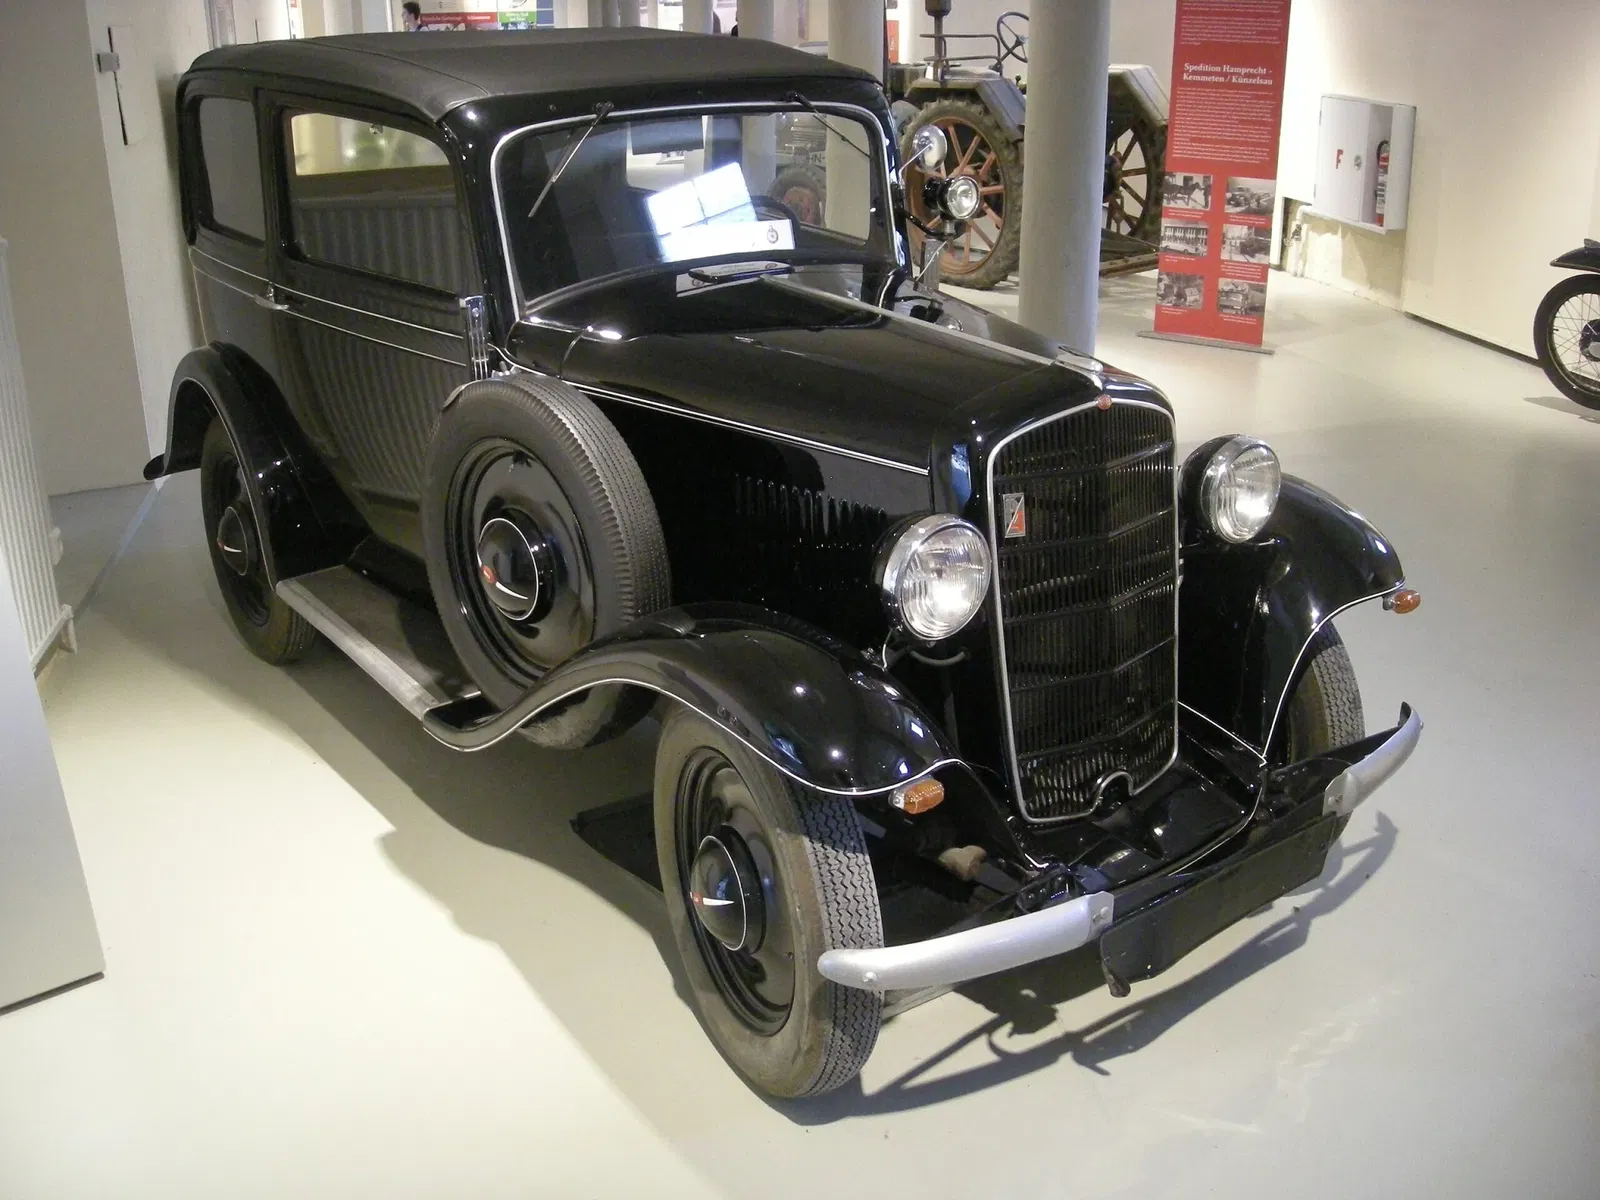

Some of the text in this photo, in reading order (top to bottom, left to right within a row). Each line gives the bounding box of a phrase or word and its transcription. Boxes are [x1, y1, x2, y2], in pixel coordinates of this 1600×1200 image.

[1184, 62, 1221, 73] Spedition
[1223, 64, 1267, 75] Hamprecht
[1183, 73, 1225, 82] Kemmeten
[1231, 75, 1273, 85] Künzelsau
